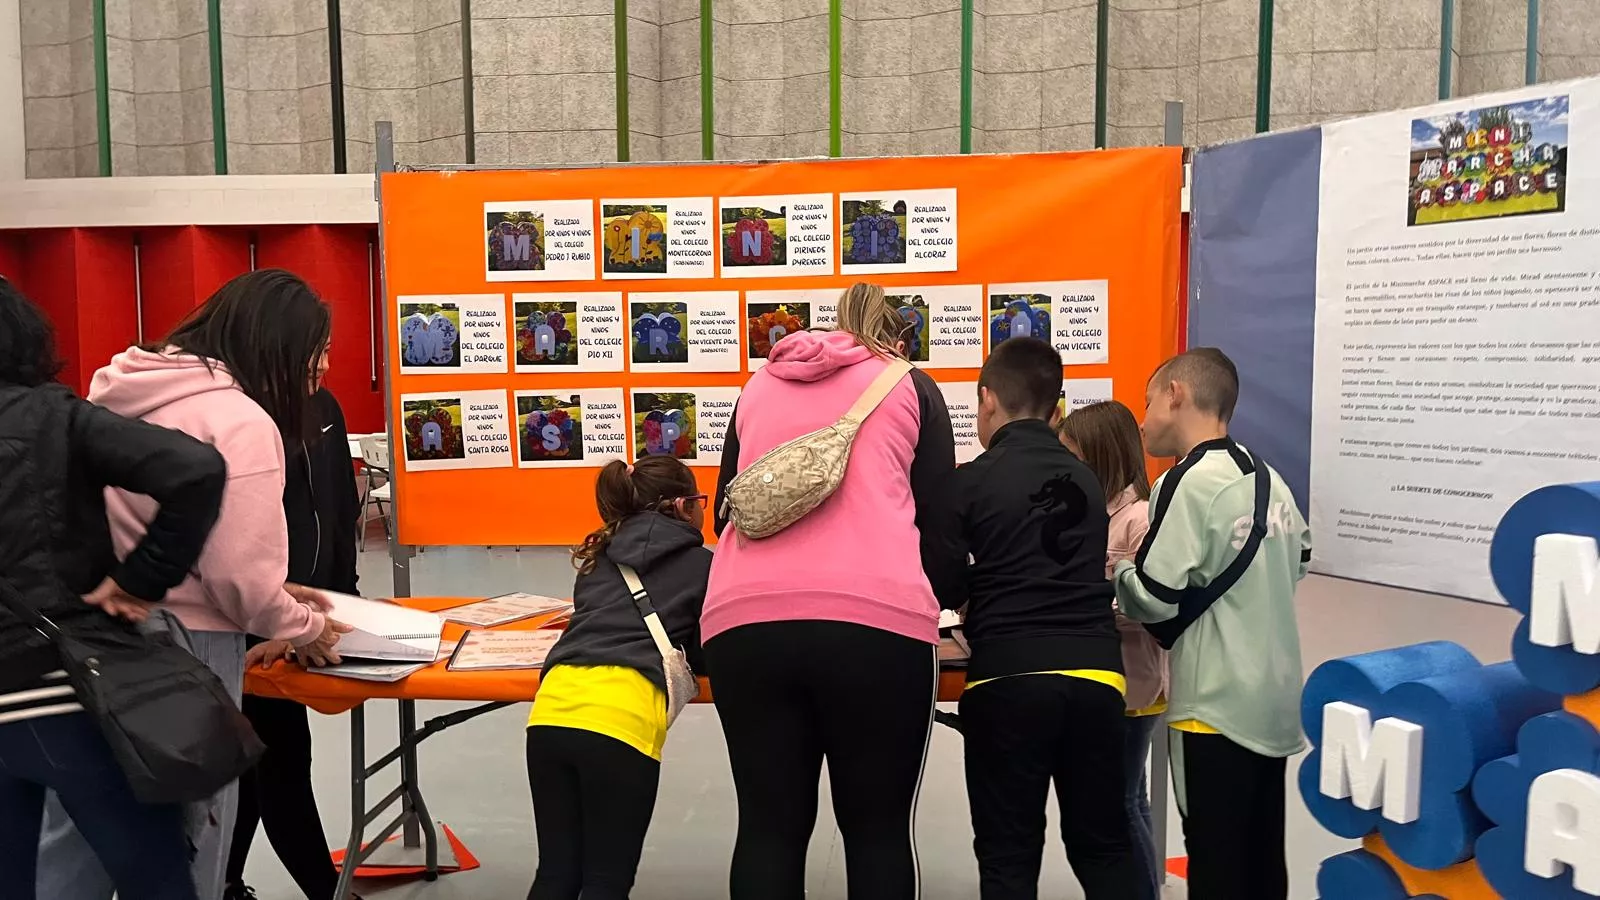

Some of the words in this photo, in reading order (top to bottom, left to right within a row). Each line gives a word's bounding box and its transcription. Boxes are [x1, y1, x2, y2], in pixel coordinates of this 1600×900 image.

[1449, 128, 1524, 149] MINI
[1420, 173, 1557, 204] ASPACE
[544, 230, 555, 238] POR
[741, 230, 762, 257] N
[503, 234, 530, 262] M
[545, 253, 565, 261] PEDRO
[534, 323, 556, 356] A
[649, 328, 670, 356] R
[1072, 329, 1102, 337] COLEGIO
[1054, 343, 1069, 352] SAN
[421, 421, 443, 452] A
[541, 424, 562, 451] S
[660, 422, 681, 449] P
[1319, 700, 1424, 825] M
